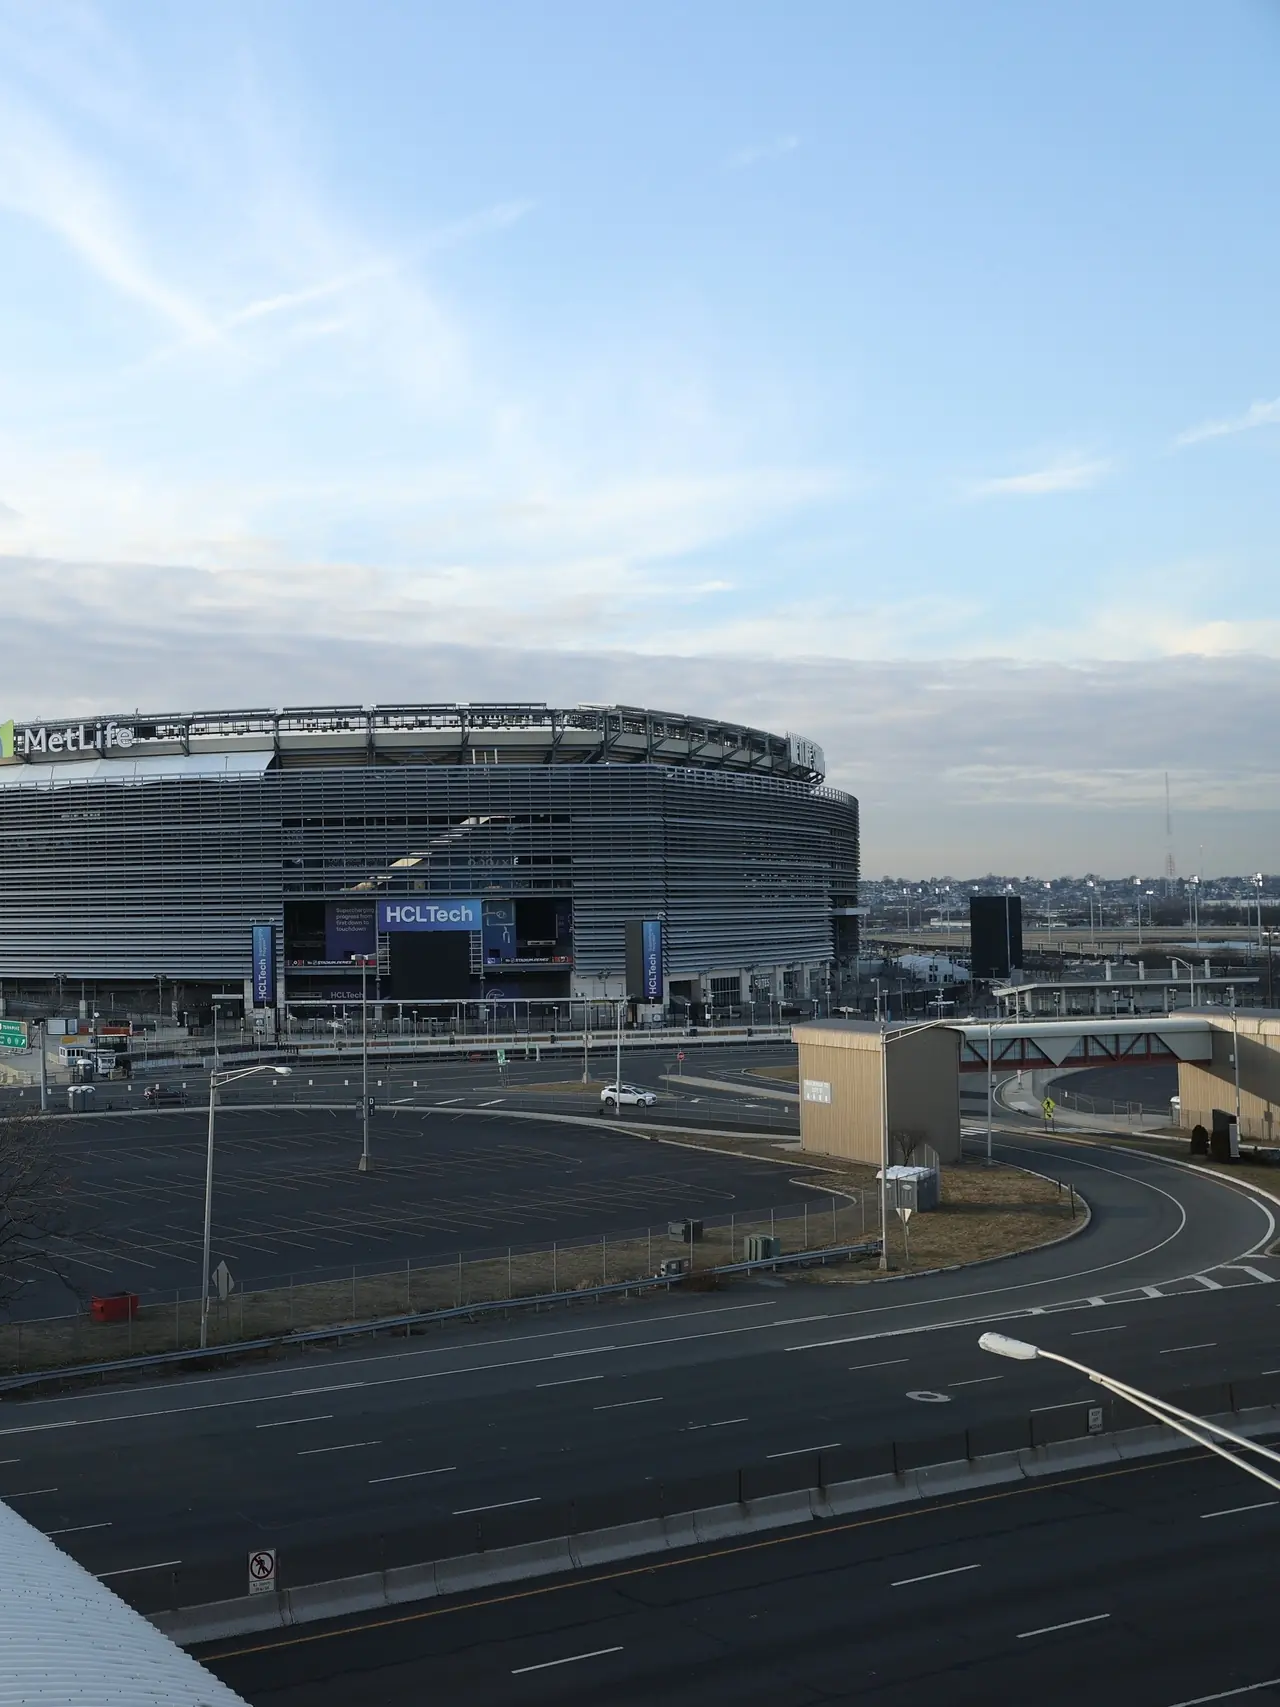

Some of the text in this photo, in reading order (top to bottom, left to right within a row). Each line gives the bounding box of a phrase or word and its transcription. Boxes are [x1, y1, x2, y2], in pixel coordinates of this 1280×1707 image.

[24, 722, 134, 753] MetLife
[386, 905, 473, 923] HCLTech
[258, 958, 267, 999] HCLTech
[648, 953, 657, 994] HCLTech
[330, 991, 365, 999] HCLTech
[369, 1097, 374, 1105] D
